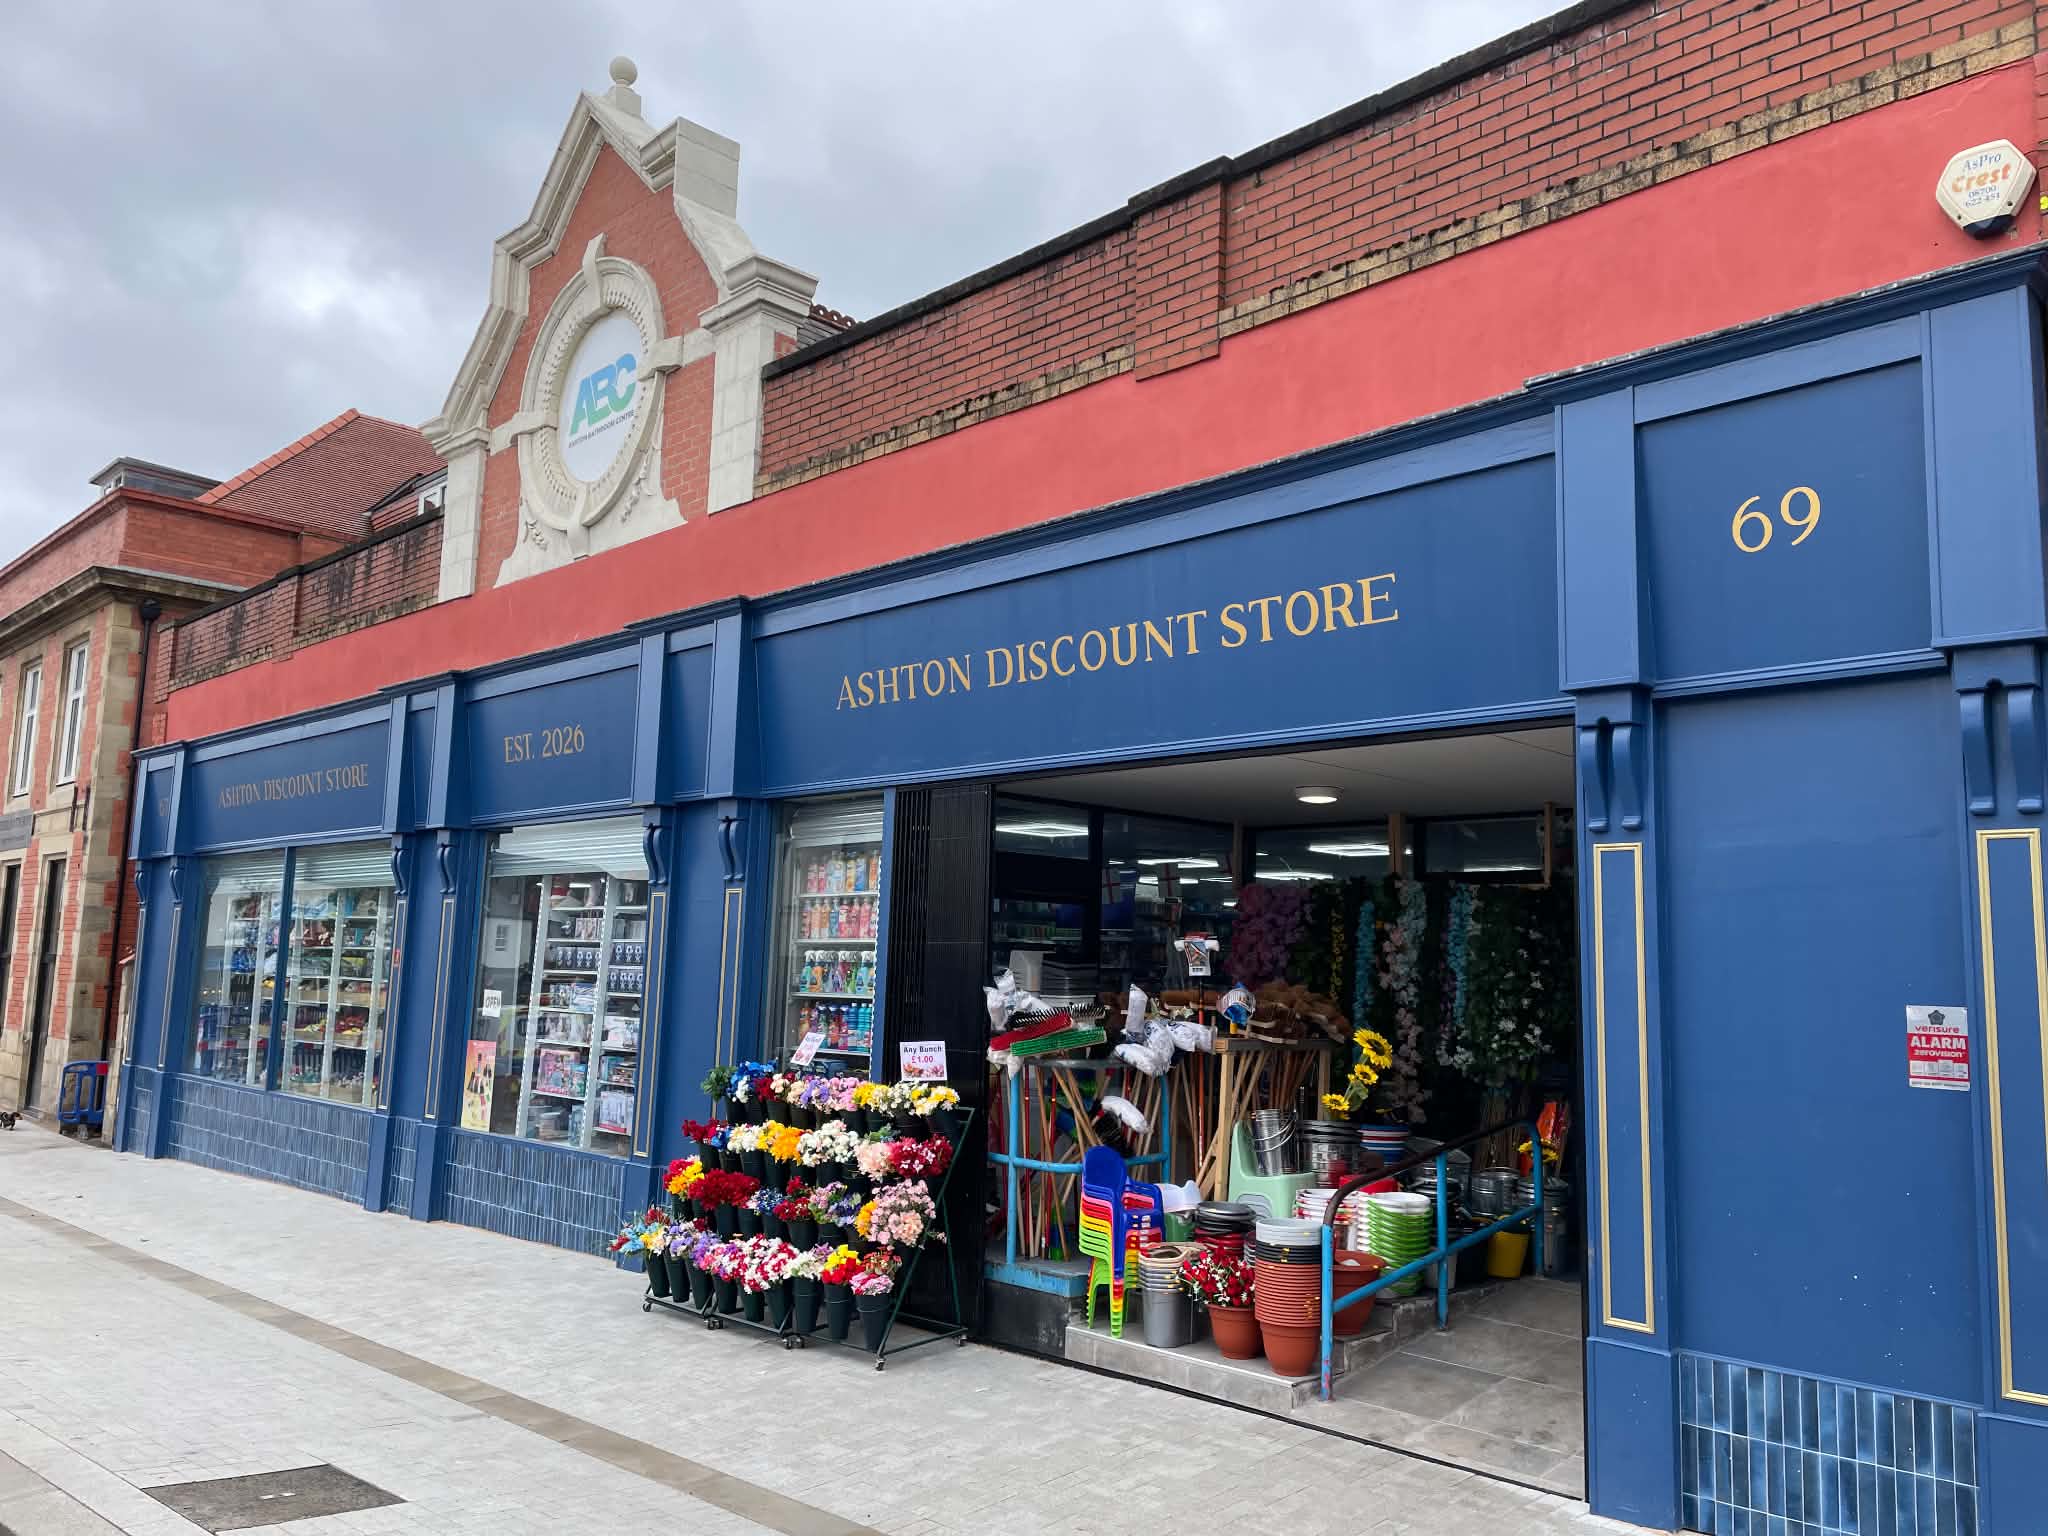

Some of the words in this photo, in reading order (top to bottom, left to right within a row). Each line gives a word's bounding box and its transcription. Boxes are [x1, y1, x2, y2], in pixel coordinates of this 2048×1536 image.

[615, 409, 635, 425] CENTRE
[1732, 486, 1821, 553] 69
[835, 654, 972, 711] ASHTON
[985, 610, 1208, 688] DISCOUNT
[1220, 572, 1399, 648] STORE
[503, 732, 535, 763] EST.
[541, 724, 585, 758] 2026
[218, 783, 261, 809] ASHTON
[263, 770, 324, 801] DISCOUNT
[325, 763, 369, 792] STORE
[1914, 1025, 1960, 1034] verisure
[903, 1046, 917, 1055] Any
[919, 1045, 942, 1053] Bunch
[1910, 1035, 1967, 1050] ALARM
[911, 1055, 934, 1064] £1.00
